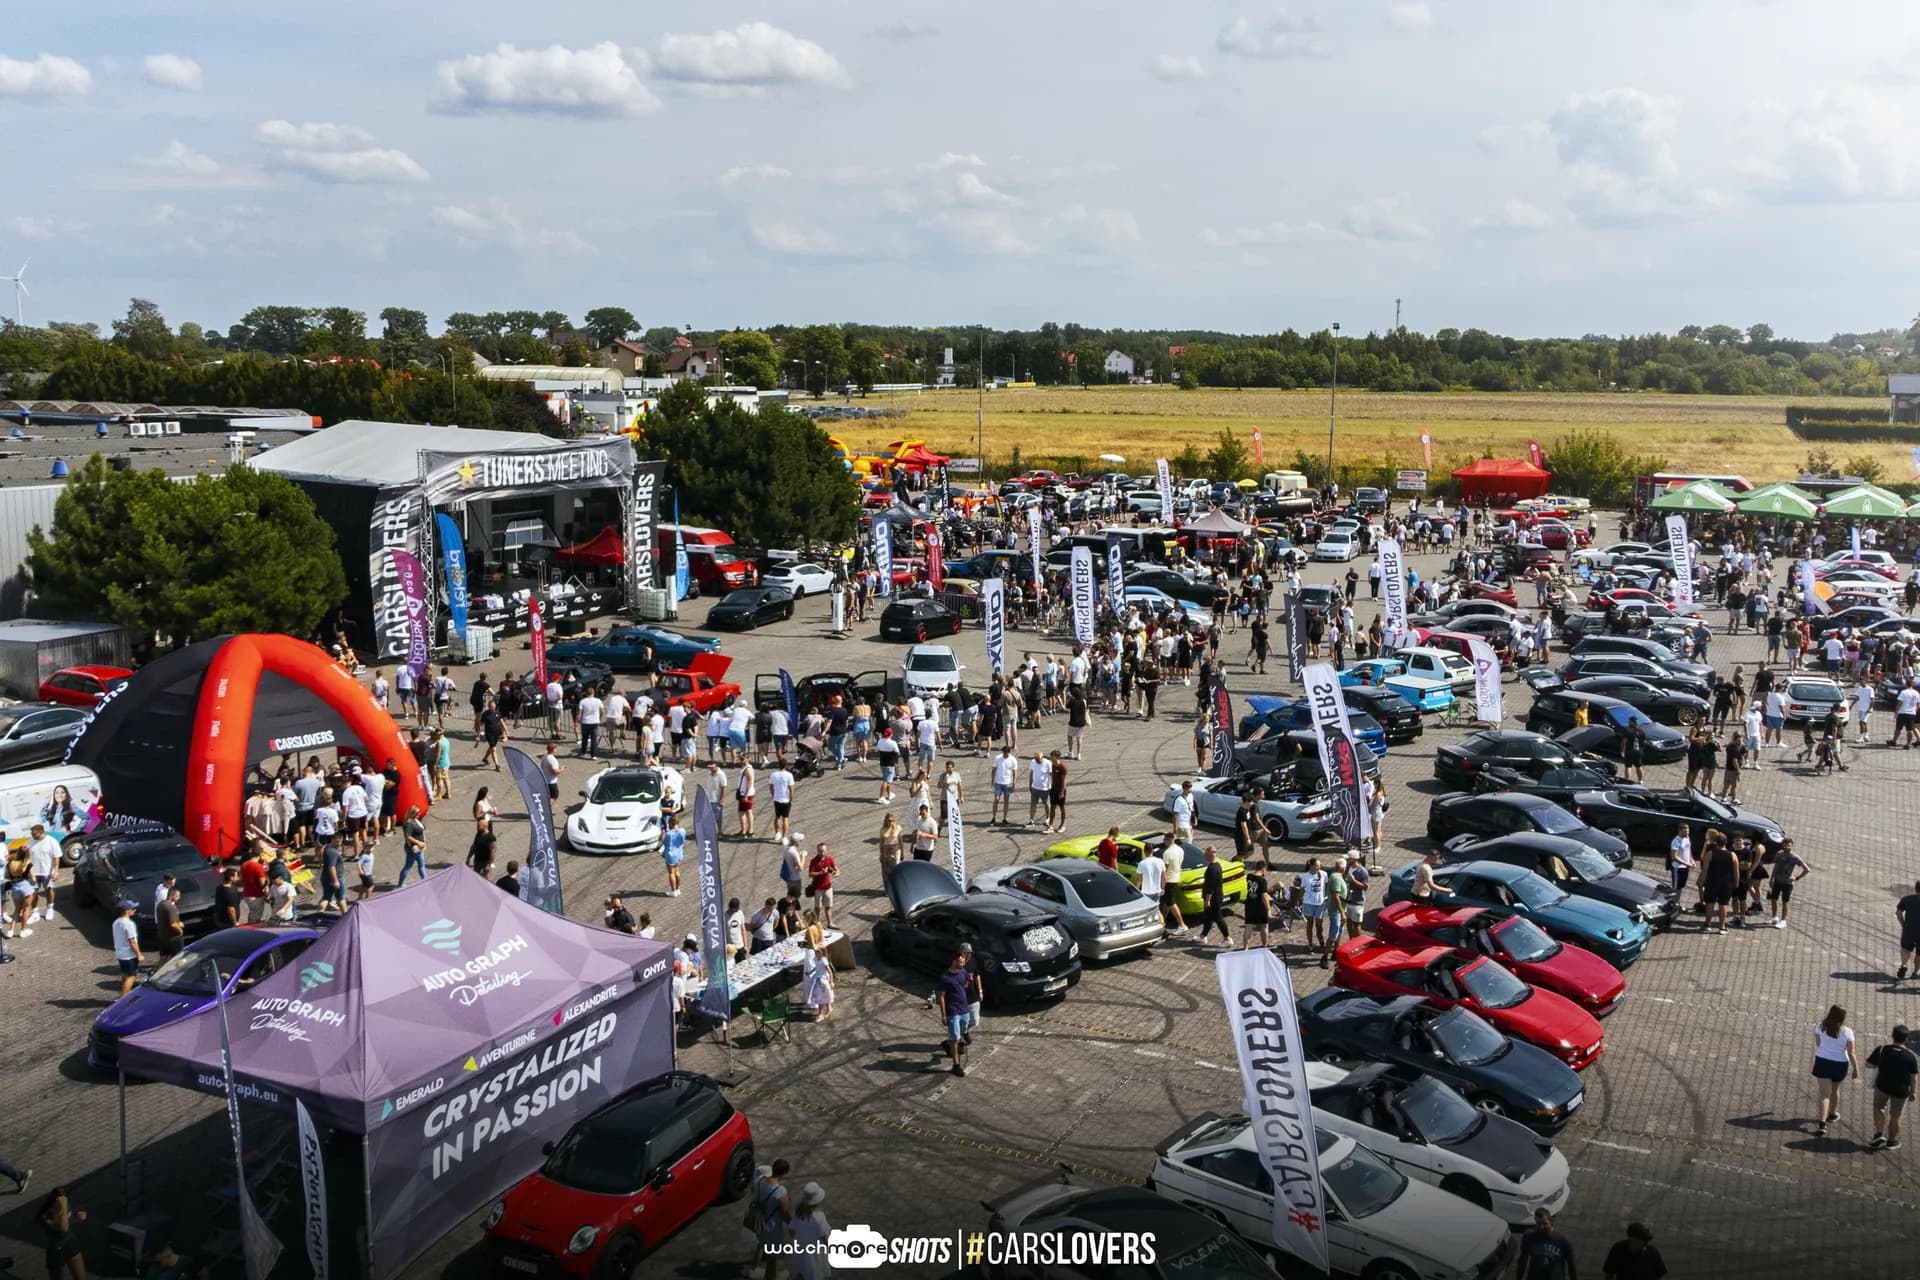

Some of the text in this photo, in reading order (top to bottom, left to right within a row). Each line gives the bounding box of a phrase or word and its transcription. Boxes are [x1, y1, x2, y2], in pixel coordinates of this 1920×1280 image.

[481, 449, 609, 487] TUNERS MEETING
[422, 934, 528, 993] AUTO GRAPH
[643, 959, 667, 979] ONYX
[450, 969, 533, 1007] Detailing
[562, 984, 617, 1024] ALEXANDRITE
[250, 1012, 312, 1042] Detailing
[251, 998, 346, 1027] AUTO GRAPH
[479, 1029, 537, 1068] AVENTURINE
[198, 1073, 279, 1102] auto-raph.eu
[423, 1012, 618, 1138] CRYSTALIZED
[396, 1078, 444, 1111] EMERALD
[432, 1056, 602, 1180] IN PASSION
